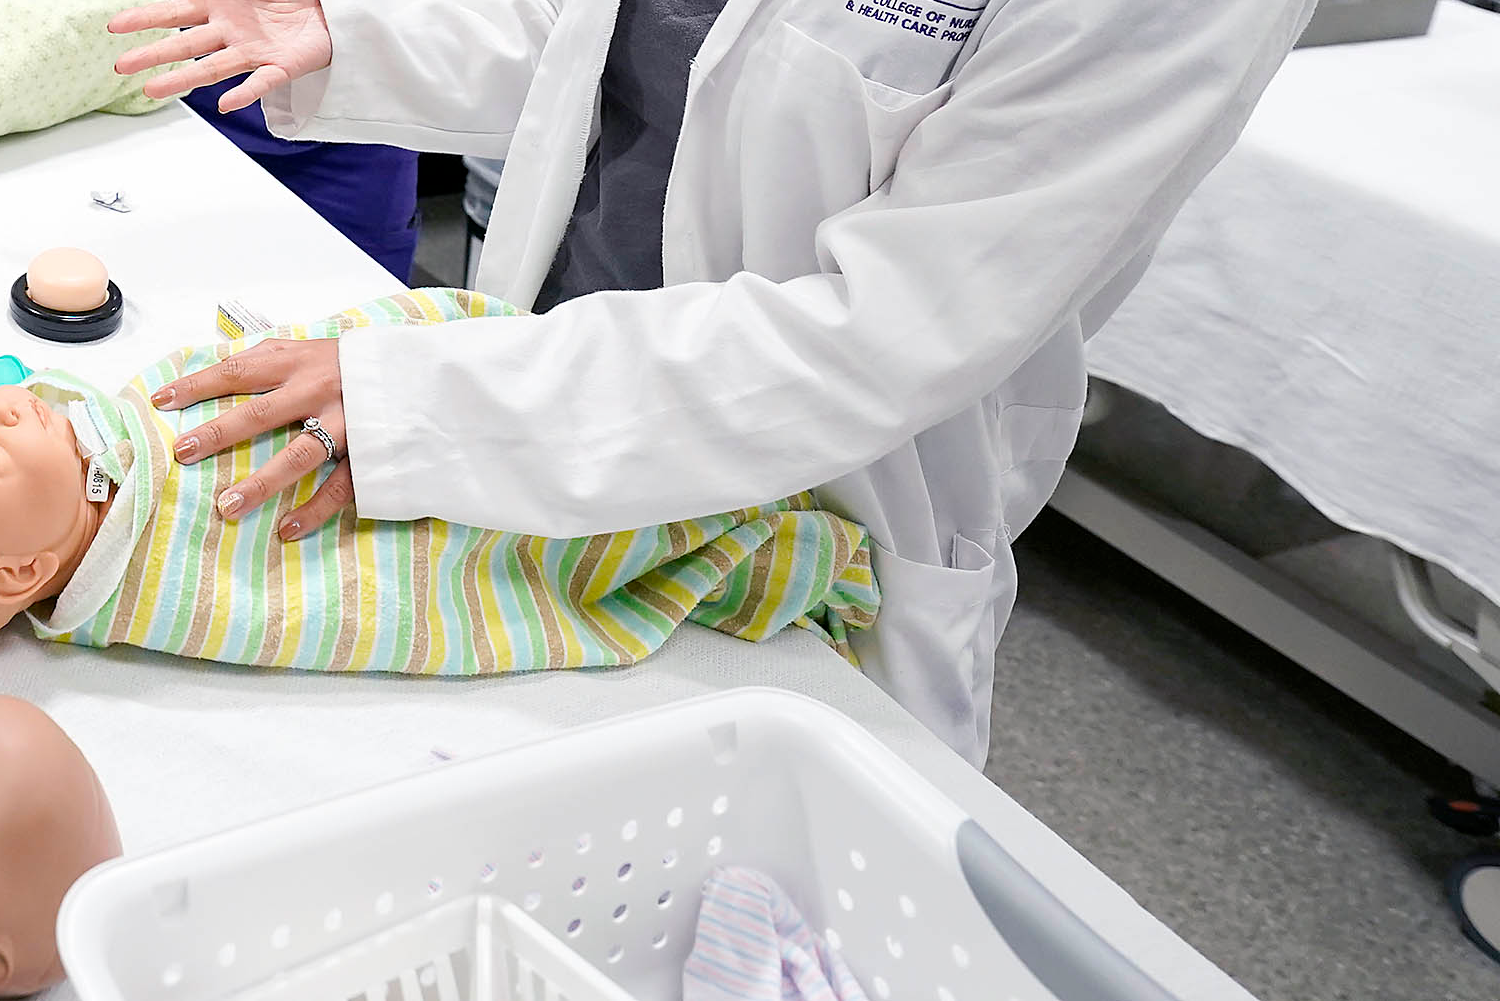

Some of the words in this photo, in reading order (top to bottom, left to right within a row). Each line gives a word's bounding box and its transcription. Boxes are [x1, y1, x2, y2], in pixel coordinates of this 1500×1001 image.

[845, 0, 855, 12] &
[857, 3, 899, 25] HEALTH
[901, 18, 938, 38] CARE
[925, 11, 947, 24] OF
